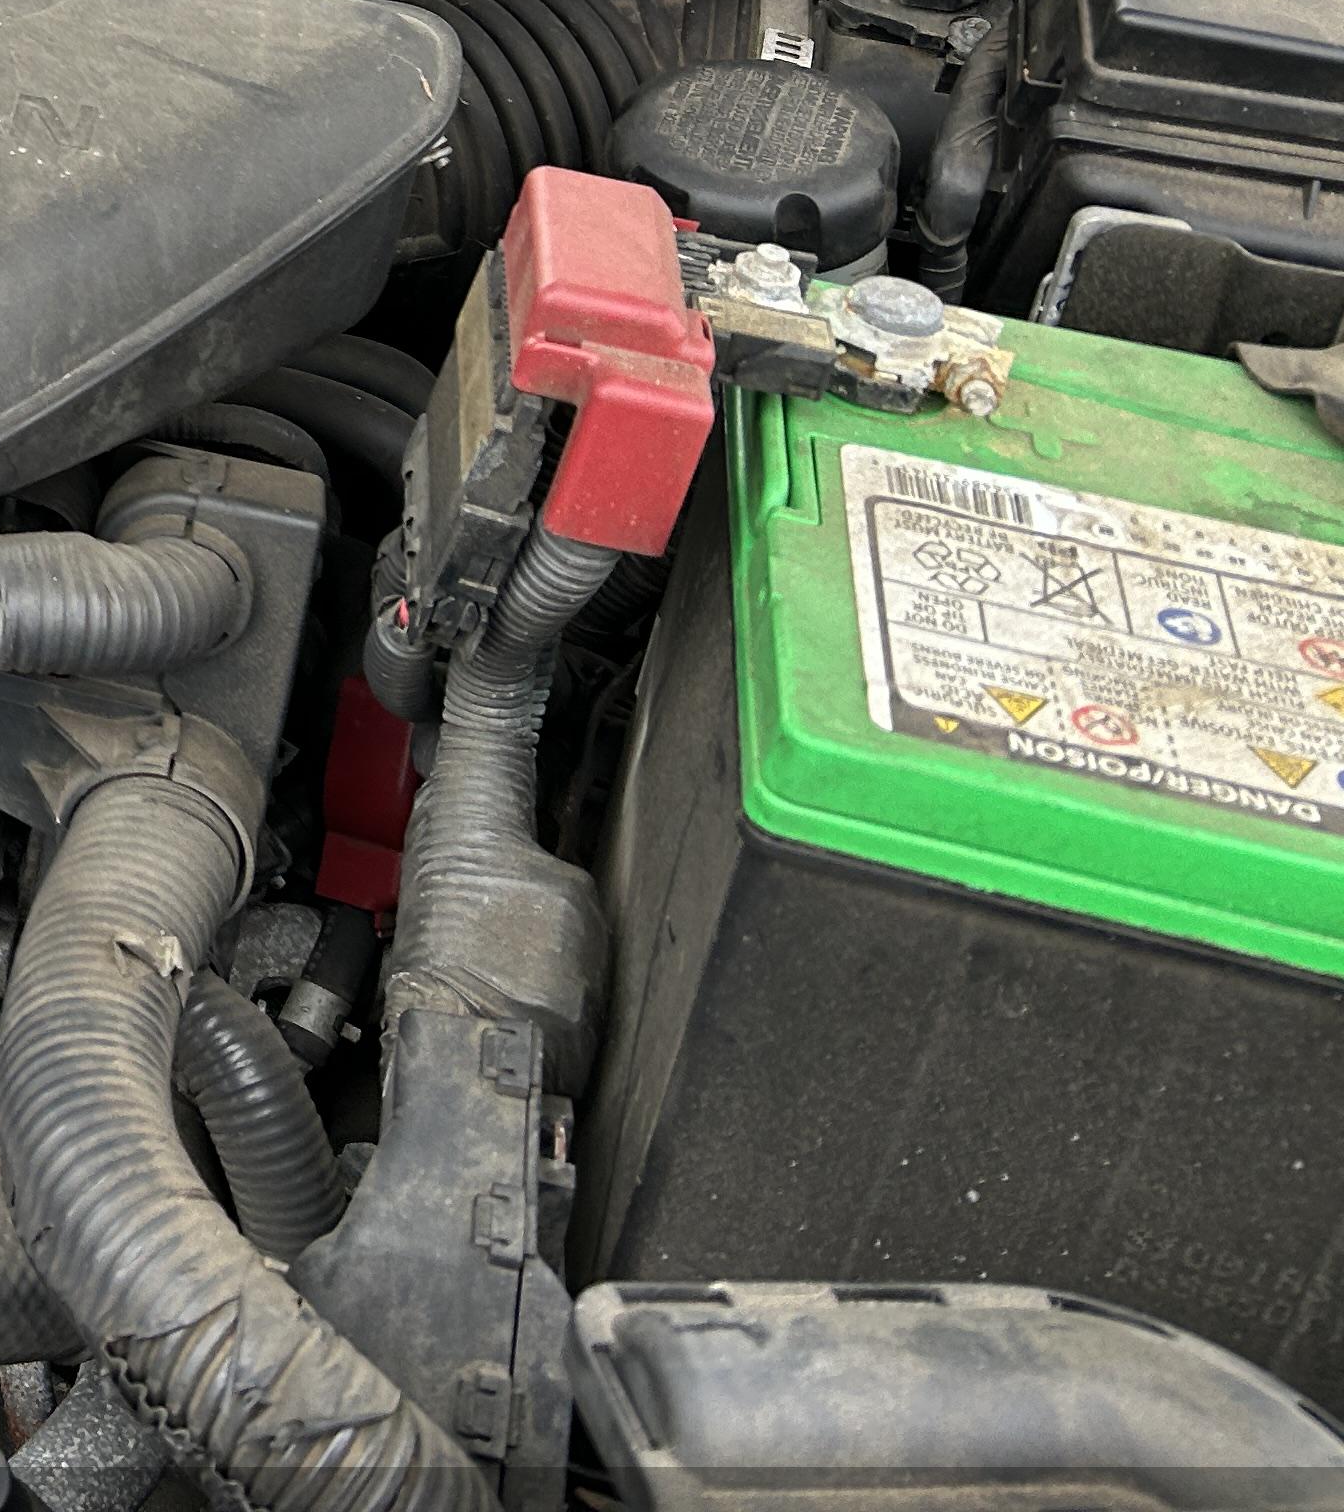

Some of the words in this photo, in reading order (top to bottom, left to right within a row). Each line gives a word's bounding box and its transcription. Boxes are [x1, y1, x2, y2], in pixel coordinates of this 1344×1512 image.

[893, 517, 938, 537] MUST
[987, 528, 1007, 541] BE
[944, 528, 1013, 554] BATTERY
[911, 600, 936, 615] OR
[1166, 591, 1211, 610] READ
[903, 609, 937, 627] NOT
[939, 607, 965, 623] TIP
[1246, 611, 1269, 626] OF
[941, 618, 967, 634] DO
[1275, 617, 1308, 634] OUT
[1065, 635, 1142, 662] MEDICAL
[912, 653, 995, 680] BLINDNESS
[965, 654, 1020, 676] SEVERE
[1148, 654, 1179, 670] GET
[999, 674, 1048, 693] CAUSE
[1023, 668, 1045, 682] OR
[1251, 677, 1300, 697] WITH
[1007, 730, 1321, 824] DANGER/POISON
